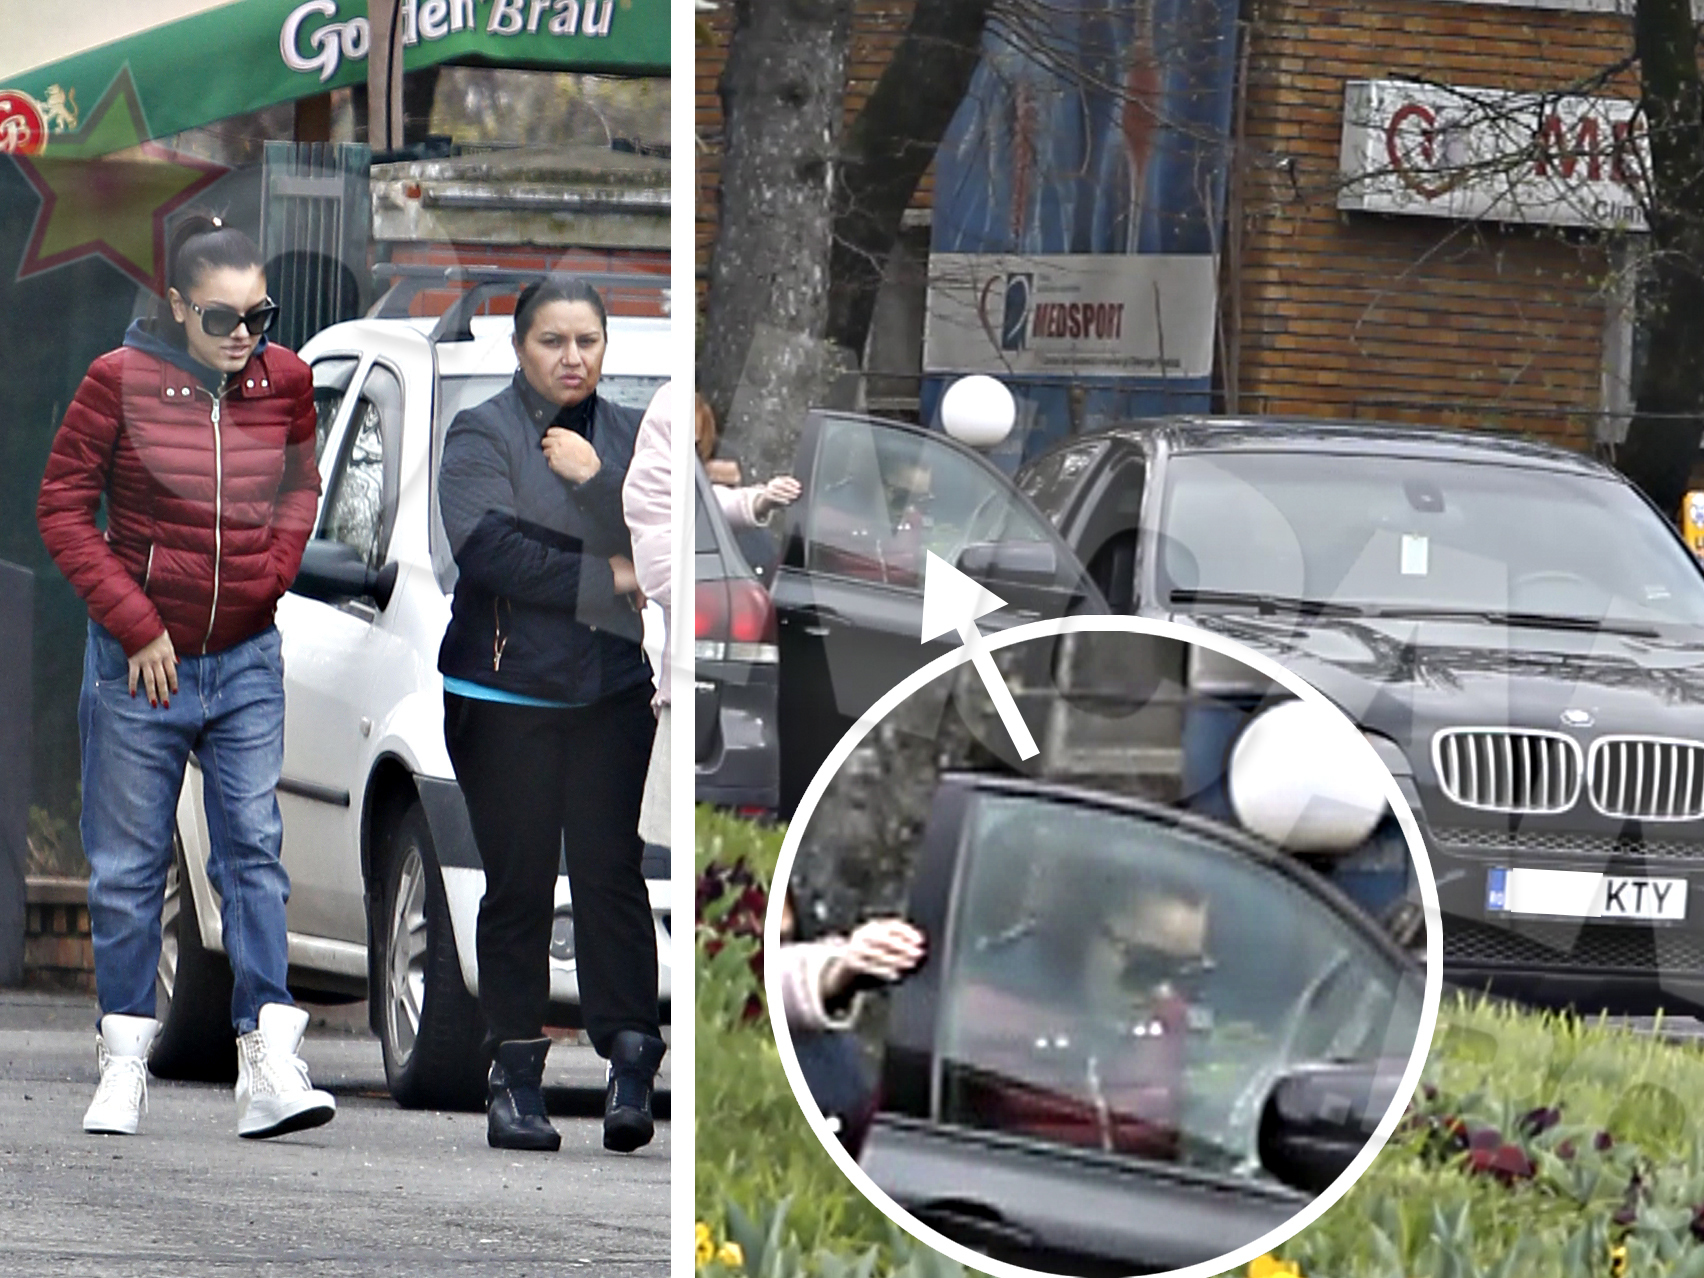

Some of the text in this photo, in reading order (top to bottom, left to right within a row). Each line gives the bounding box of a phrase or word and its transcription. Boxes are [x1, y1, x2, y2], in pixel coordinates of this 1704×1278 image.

[279, 0, 476, 82] Goden
[1032, 302, 1125, 340] MEDSPORT
[1604, 878, 1674, 914] KTY
